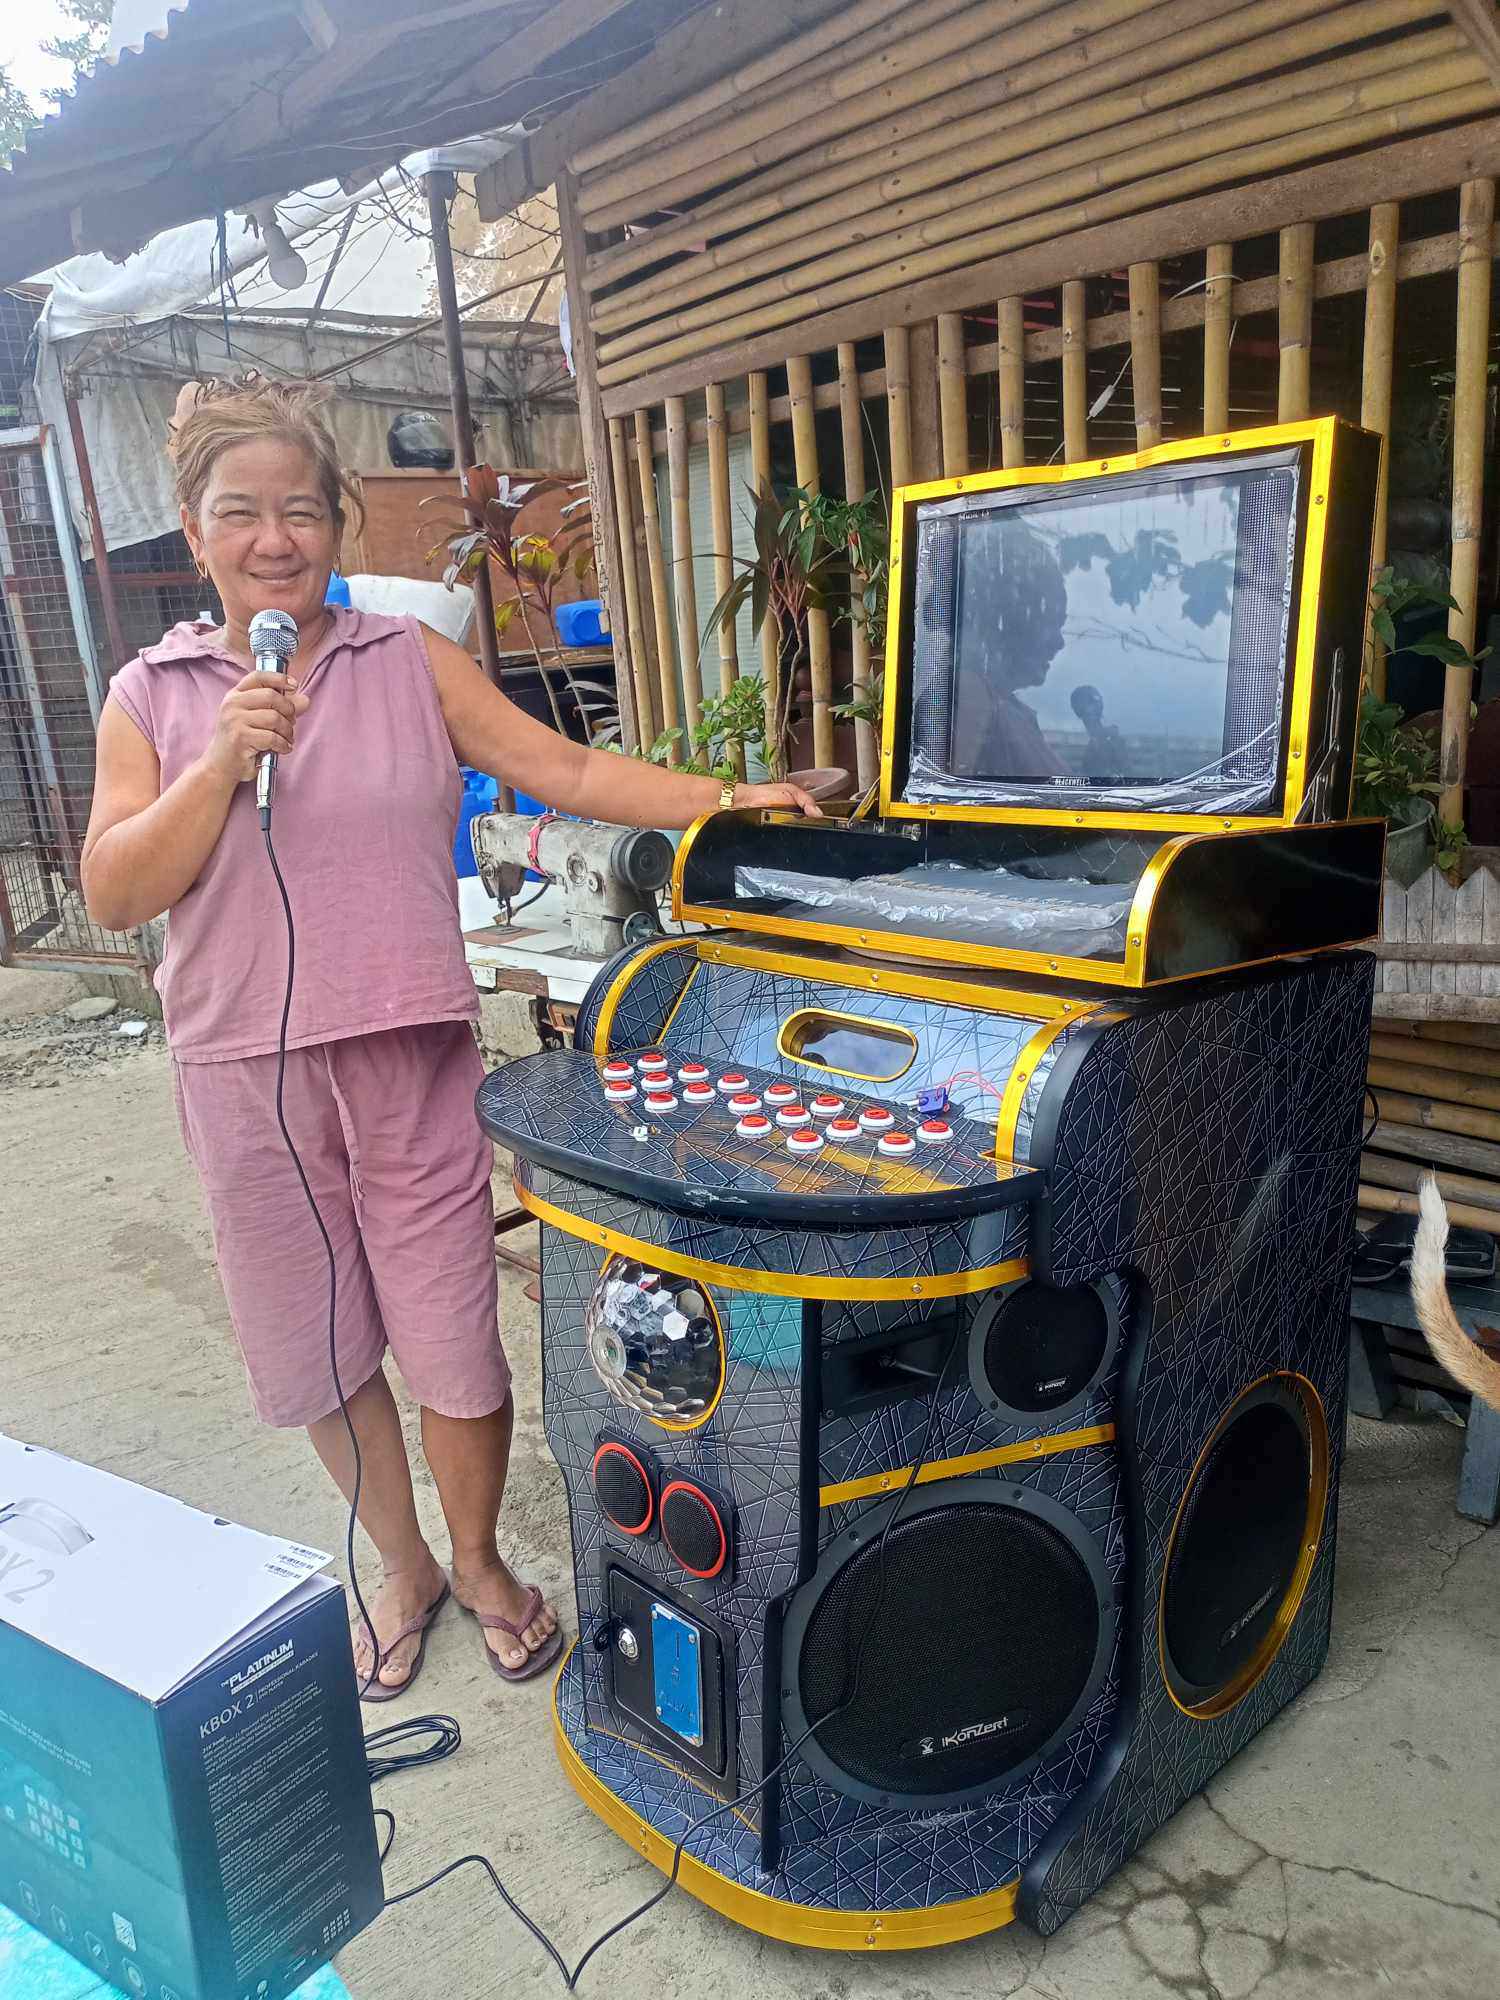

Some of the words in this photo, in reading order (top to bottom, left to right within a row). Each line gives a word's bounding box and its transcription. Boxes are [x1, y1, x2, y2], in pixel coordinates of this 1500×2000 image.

[4, 1568, 55, 1604] 2
[229, 1639, 293, 1688] PLATINUM
[200, 1701, 242, 1738] KBOX
[245, 1694, 255, 1709] 2
